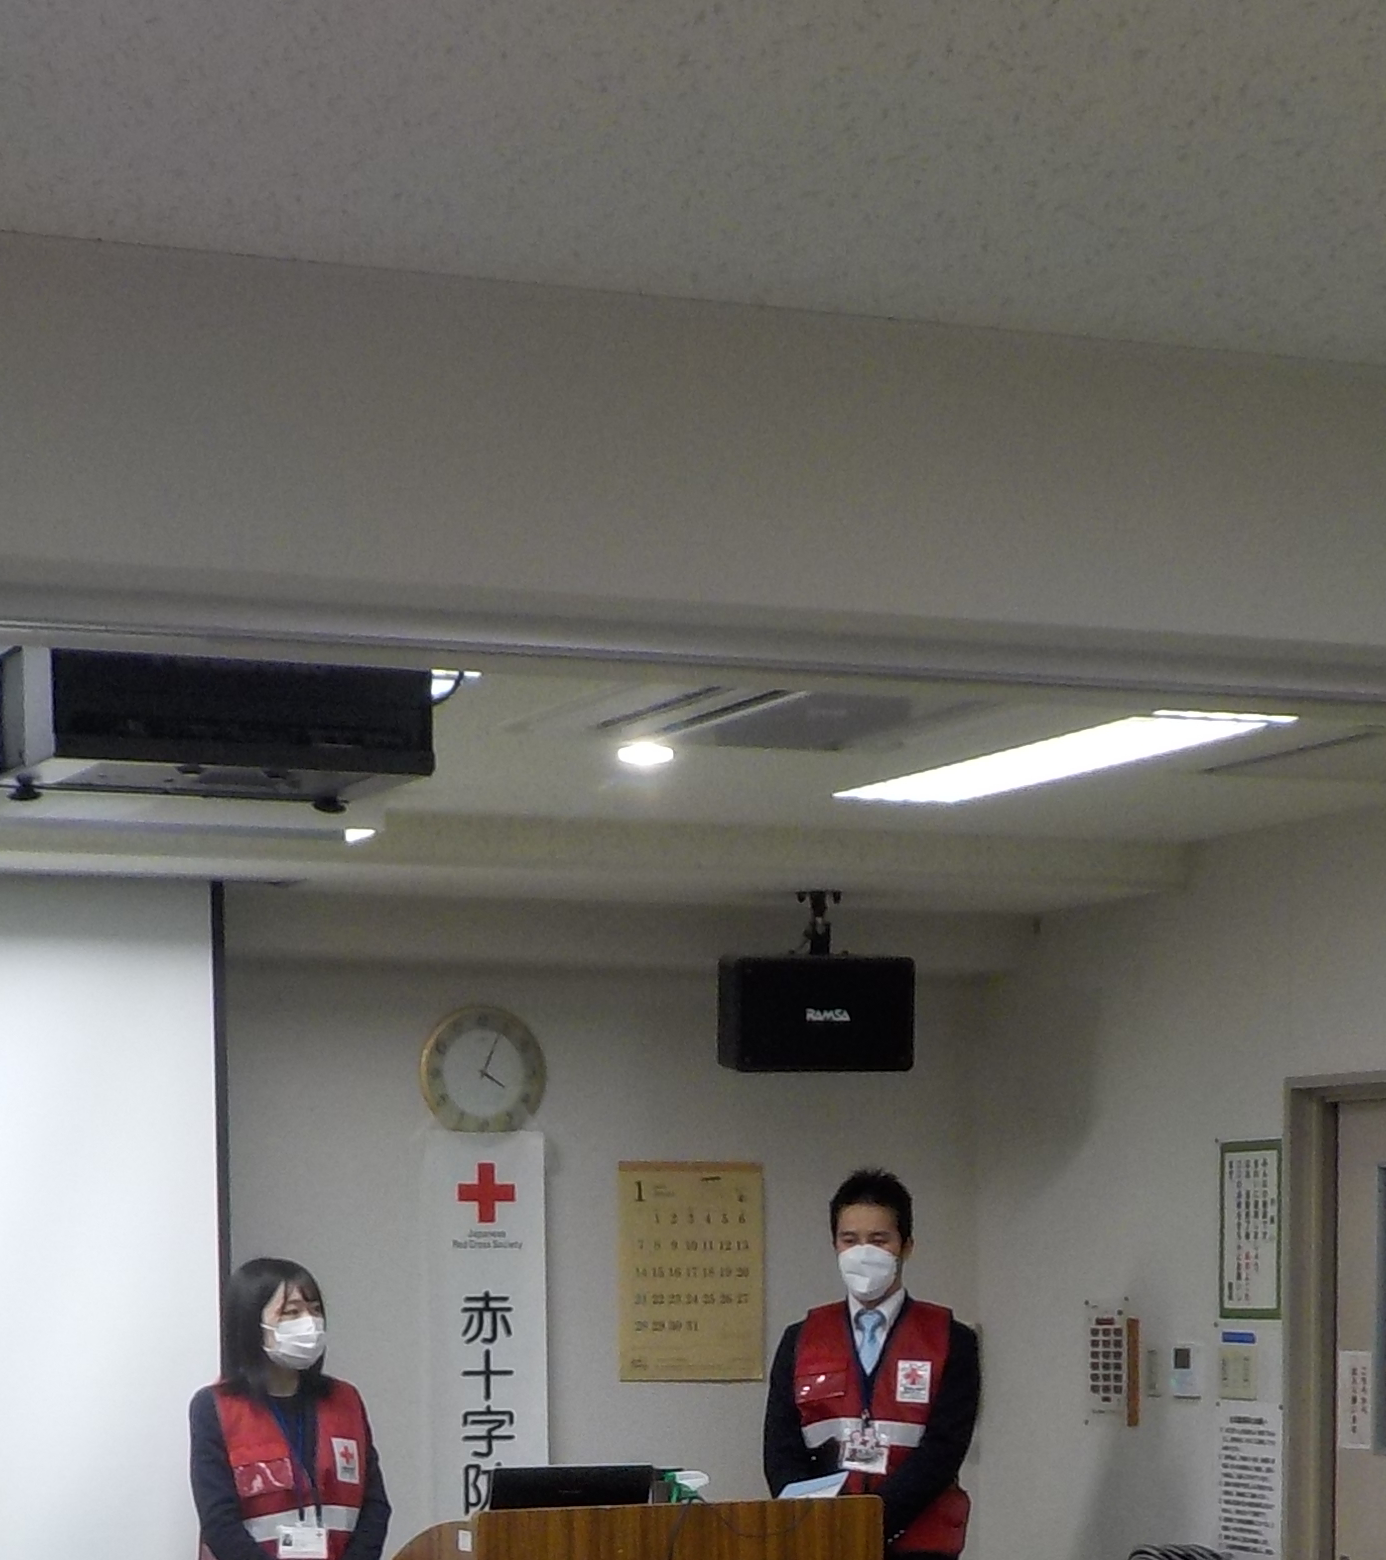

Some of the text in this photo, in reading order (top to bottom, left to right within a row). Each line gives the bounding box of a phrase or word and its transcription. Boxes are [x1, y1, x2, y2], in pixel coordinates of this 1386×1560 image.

[805, 1008, 851, 1021] RAMSA
[634, 1180, 646, 1201] 1
[655, 1213, 747, 1225] 1 2 3 4 5 6
[671, 1240, 679, 1251] 9
[686, 1240, 699, 1251] 10
[702, 1240, 714, 1251] 11
[719, 1240, 732, 1251] 12
[737, 1240, 750, 1251] 13
[652, 1267, 666, 1278] 15
[669, 1267, 682, 1278] 16
[686, 1267, 699, 1278] 17
[720, 1267, 733, 1278] 19
[736, 1267, 750, 1278] 20
[652, 1293, 666, 1305] 22
[669, 1293, 682, 1305] 23
[686, 1293, 699, 1305] 24
[702, 1293, 717, 1305] 25
[720, 1293, 733, 1305] 26
[737, 1293, 750, 1305] 27
[652, 1320, 666, 1332] 29
[668, 1320, 683, 1332] 30
[686, 1320, 700, 1332] 31
